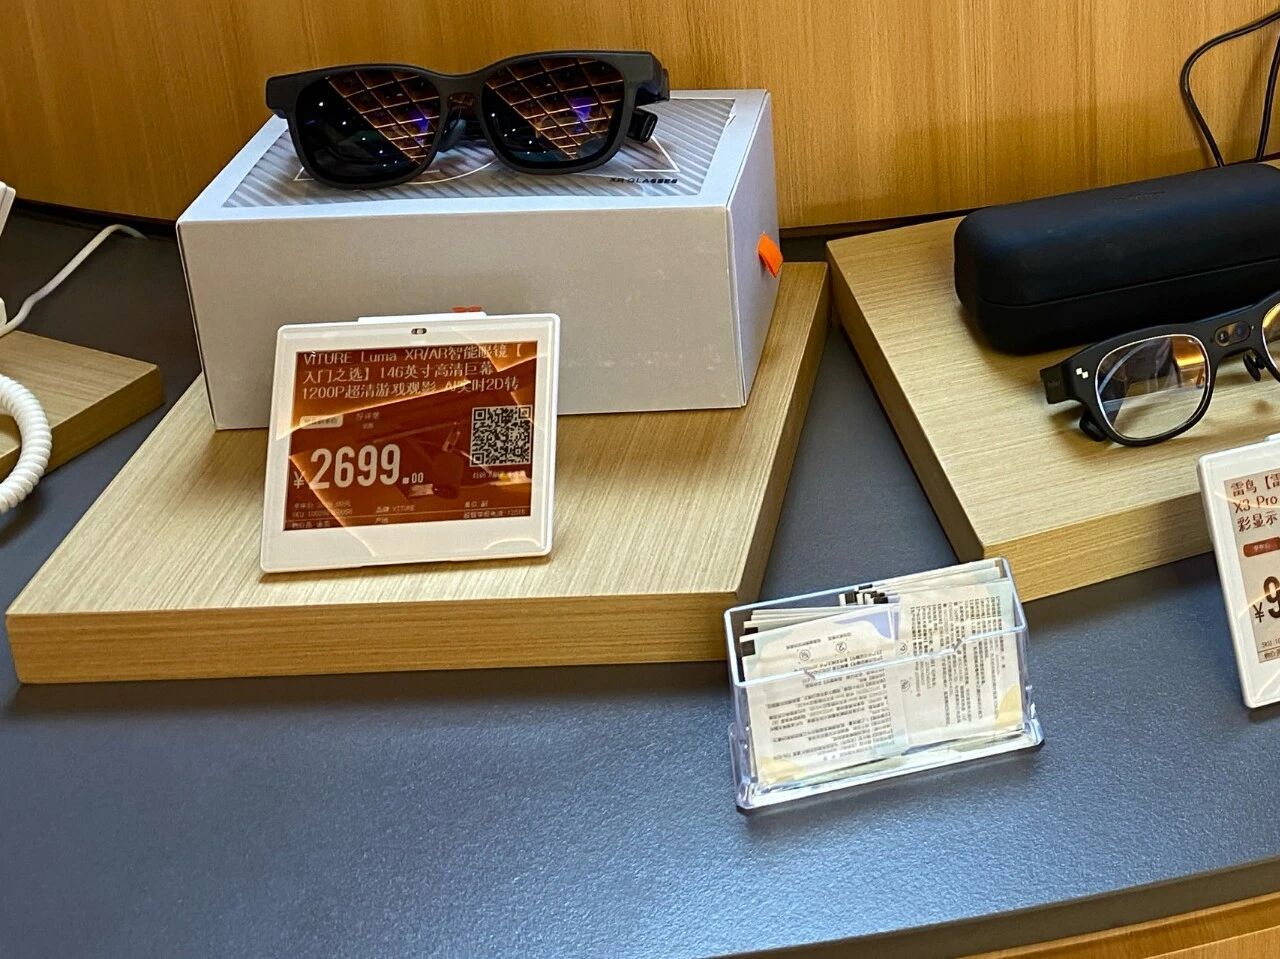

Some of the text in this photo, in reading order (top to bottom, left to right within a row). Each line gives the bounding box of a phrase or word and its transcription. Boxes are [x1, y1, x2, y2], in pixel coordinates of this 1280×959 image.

[303, 350, 353, 365] VITURE
[361, 348, 397, 362] Luma
[1230, 478, 1257, 497] 雷鸟
[1233, 498, 1251, 514] X3
[1256, 491, 1278, 508] Pro
[1236, 510, 1279, 532] 彩显示
